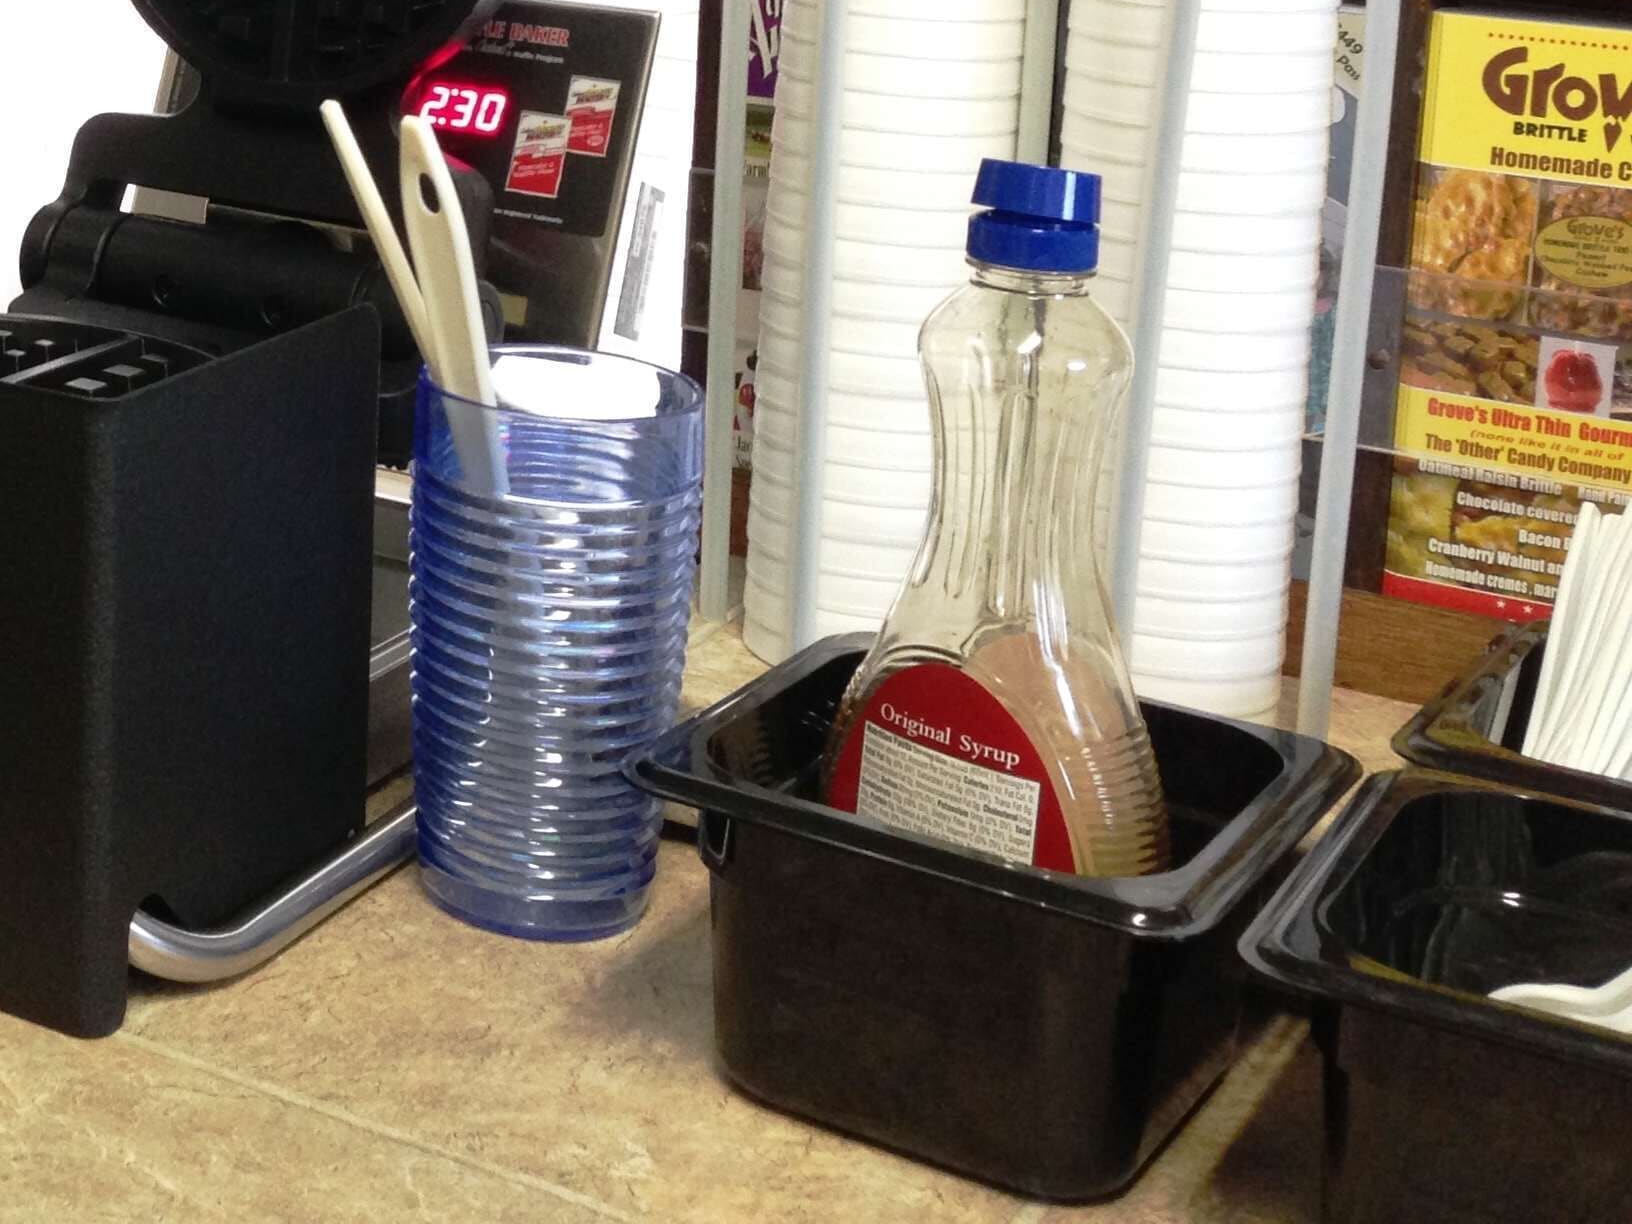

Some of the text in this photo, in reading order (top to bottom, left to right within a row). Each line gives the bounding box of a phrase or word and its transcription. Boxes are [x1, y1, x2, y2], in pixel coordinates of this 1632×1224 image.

[419, 86, 506, 132] 2:30
[1513, 121, 1587, 143] BRITTLE
[1490, 146, 1613, 179] Homemade
[1428, 397, 1571, 438] Grove's Ultra Thin
[1425, 433, 1452, 452] The
[1507, 447, 1555, 472] Candy
[1558, 455, 1631, 485] Company
[1470, 429, 1623, 461] (none like it in all of
[1418, 457, 1562, 496] Oatmeal Raisin Brittle
[1456, 490, 1525, 516] Chocolate
[1428, 537, 1544, 572] Cranberry Walnut
[1519, 528, 1560, 550] Bacon
[1426, 560, 1528, 594] Homemade cremes
[880, 702, 1020, 770] Original Syrup
